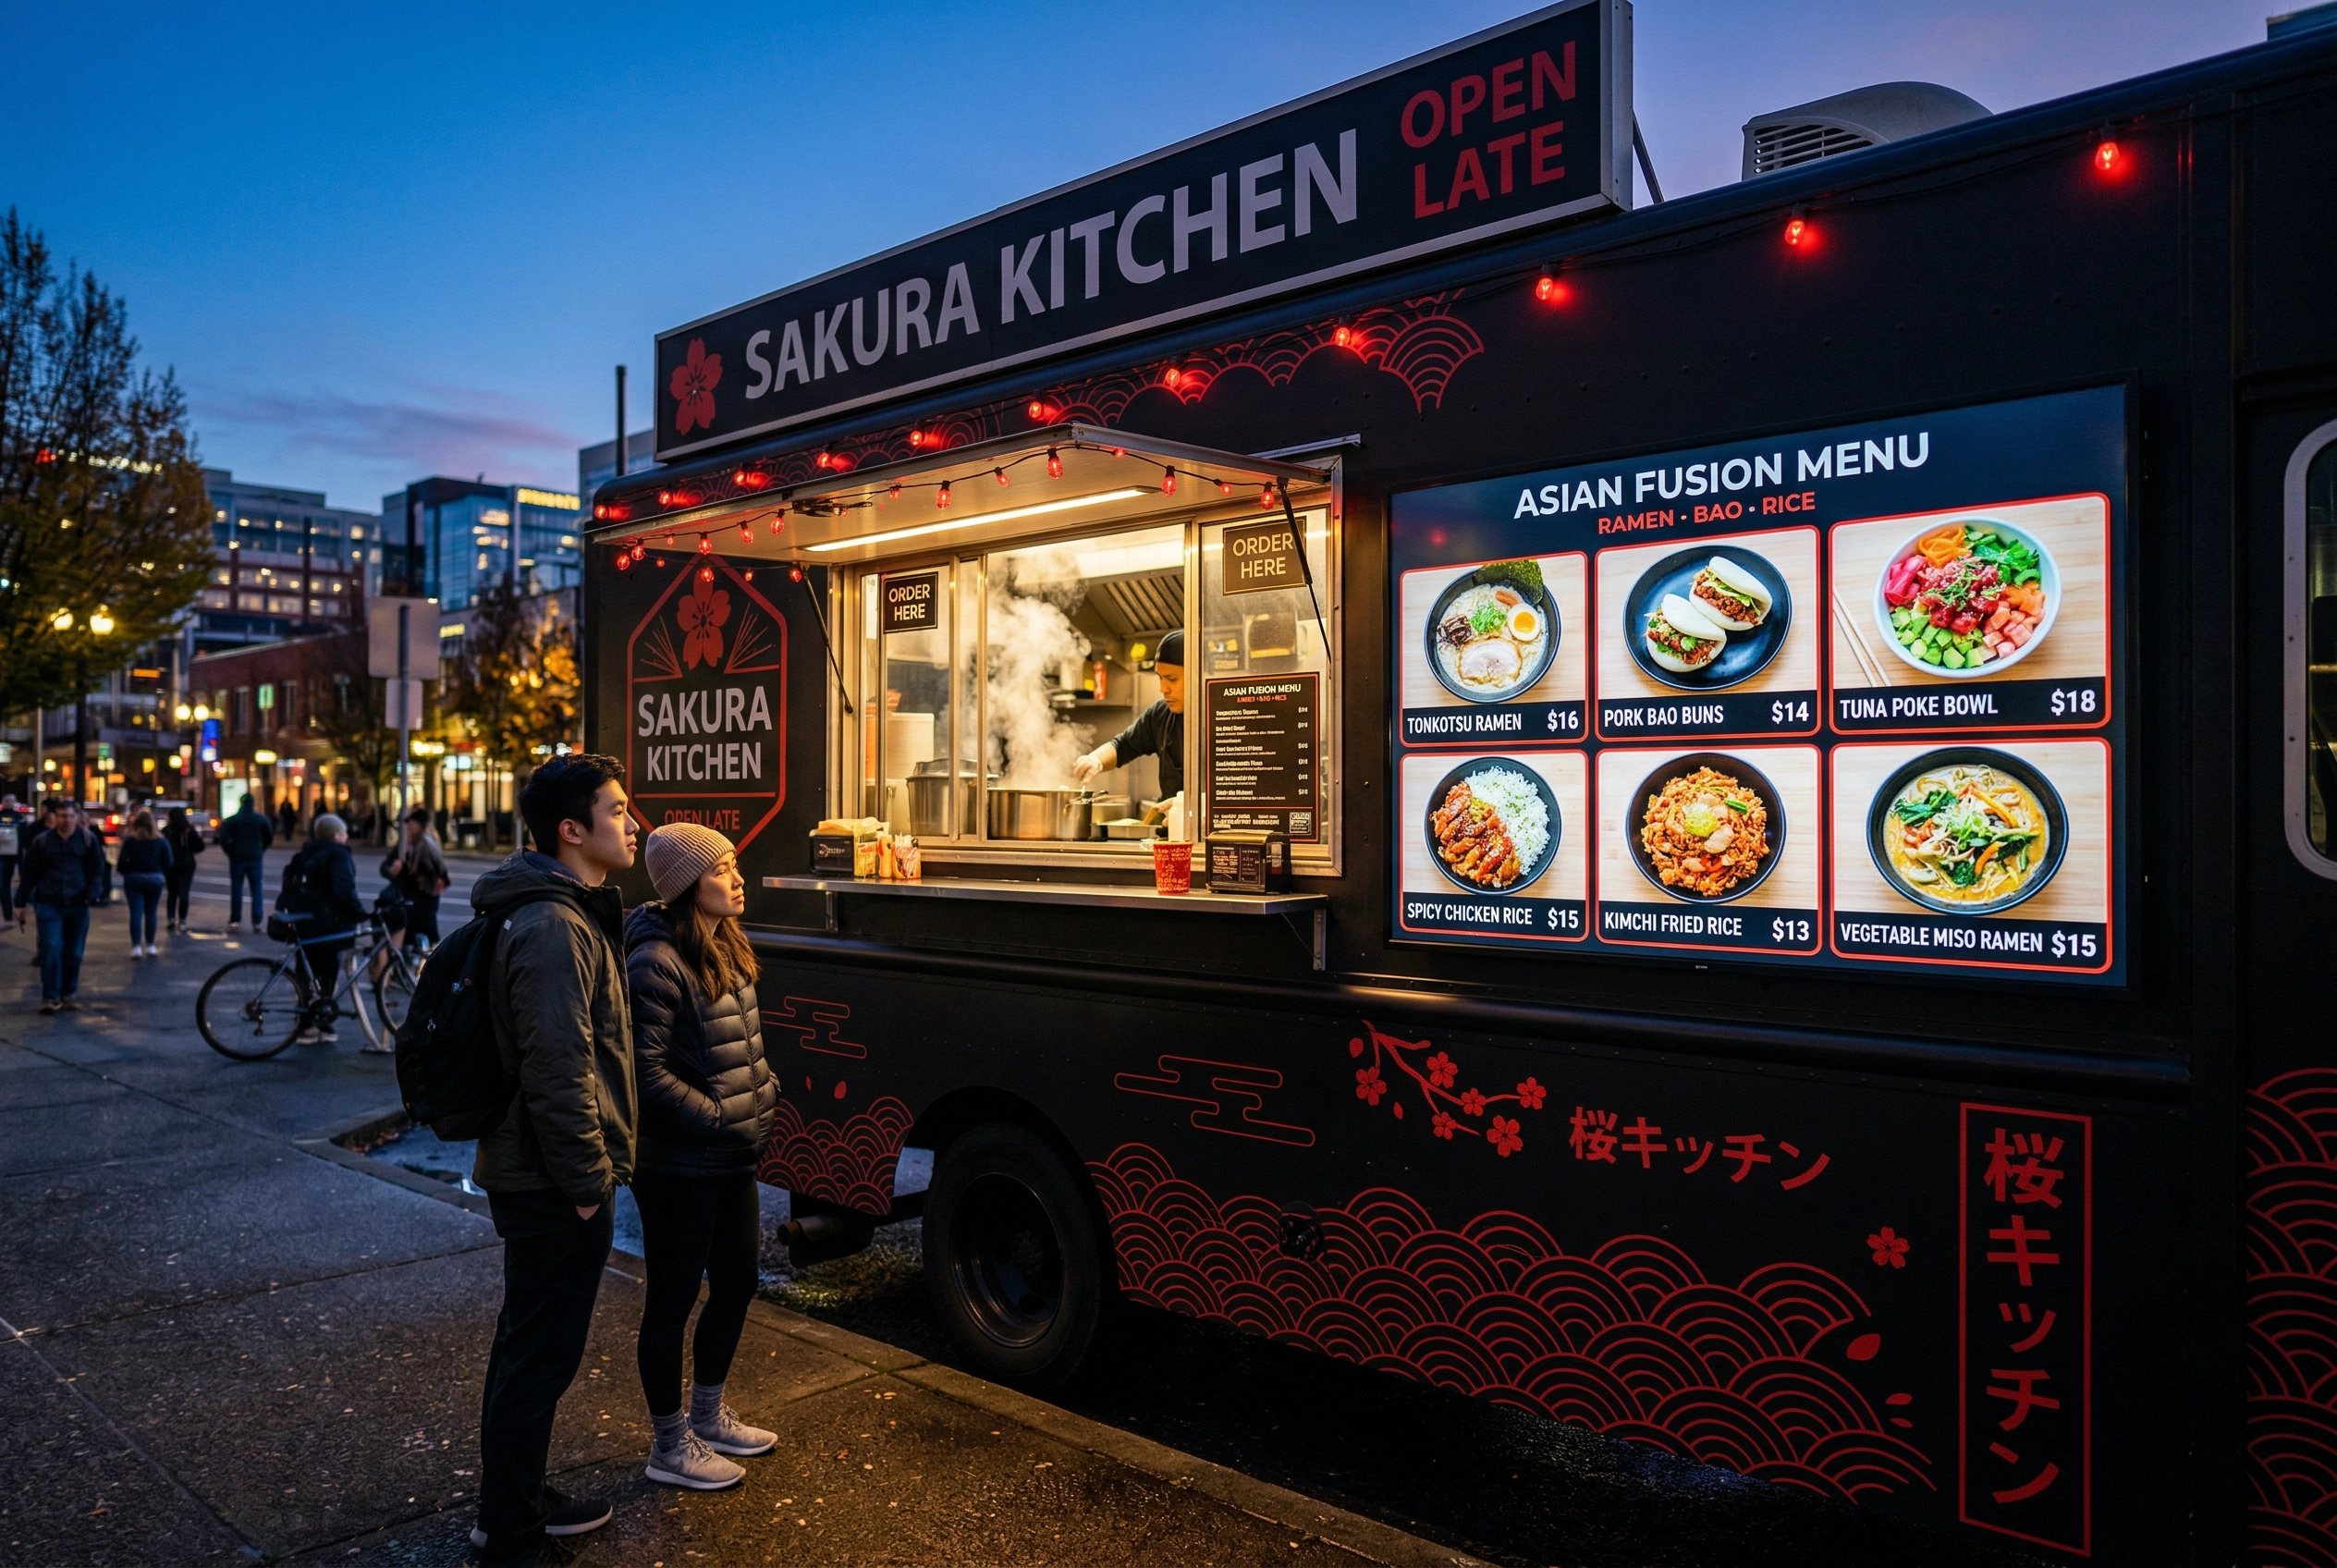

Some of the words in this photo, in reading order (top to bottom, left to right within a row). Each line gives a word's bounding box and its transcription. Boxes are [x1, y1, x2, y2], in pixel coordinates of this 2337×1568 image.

[1401, 41, 1576, 149] OPEN
[1413, 120, 1565, 219] LATE
[745, 262, 980, 399] SAKURA
[1000, 129, 1357, 325] KITCHEN
[1513, 476, 1622, 519] ASIAN
[1635, 453, 1782, 504] FUSION
[1797, 432, 1929, 483] MENU
[1597, 508, 1675, 534] RAMEN
[1694, 501, 1744, 523] BAO
[1762, 491, 1816, 515] RICE
[1232, 533, 1293, 557] ORDER
[1240, 557, 1287, 579] HERE
[888, 583, 930, 603] ORDER
[894, 603, 925, 621] HERE
[1223, 688, 1247, 697] ASIAN
[1278, 683, 1302, 693] MENU
[2050, 688, 2096, 717] $18
[638, 685, 773, 737] SAKURA
[1604, 707, 1643, 728] PORK
[1647, 706, 1678, 726] BAO
[1682, 704, 1724, 725] BUNS
[1771, 700, 1809, 724] $14
[1840, 698, 1888, 719] TUNA
[1891, 695, 1939, 717] POKE
[1943, 693, 1999, 716] BOWL
[1407, 715, 1472, 734] TONKOTSU
[1475, 713, 1522, 732] RAMEN
[1547, 709, 1579, 732] $16
[647, 741, 762, 781] KITCHEN
[665, 809, 702, 825] OPEN
[705, 809, 740, 829] LATE
[1407, 902, 1442, 923] SPICY
[1444, 904, 1499, 924] CHICKEN
[1503, 907, 1533, 925] RICE
[1548, 906, 1579, 930] $15
[1605, 912, 1657, 932] KIMCHI
[1660, 913, 1704, 934] FRIED
[1707, 916, 1743, 937] RICE
[1772, 916, 1810, 943] $13
[1840, 923, 1930, 946] VEGETABLE
[1933, 927, 1976, 949] MISO
[1980, 929, 2043, 952] RAMEN
[2050, 929, 2097, 959] $15
[1569, 1106, 1830, 1190] 桜キッチン
[1984, 1127, 2064, 1503] 桜キッチン
